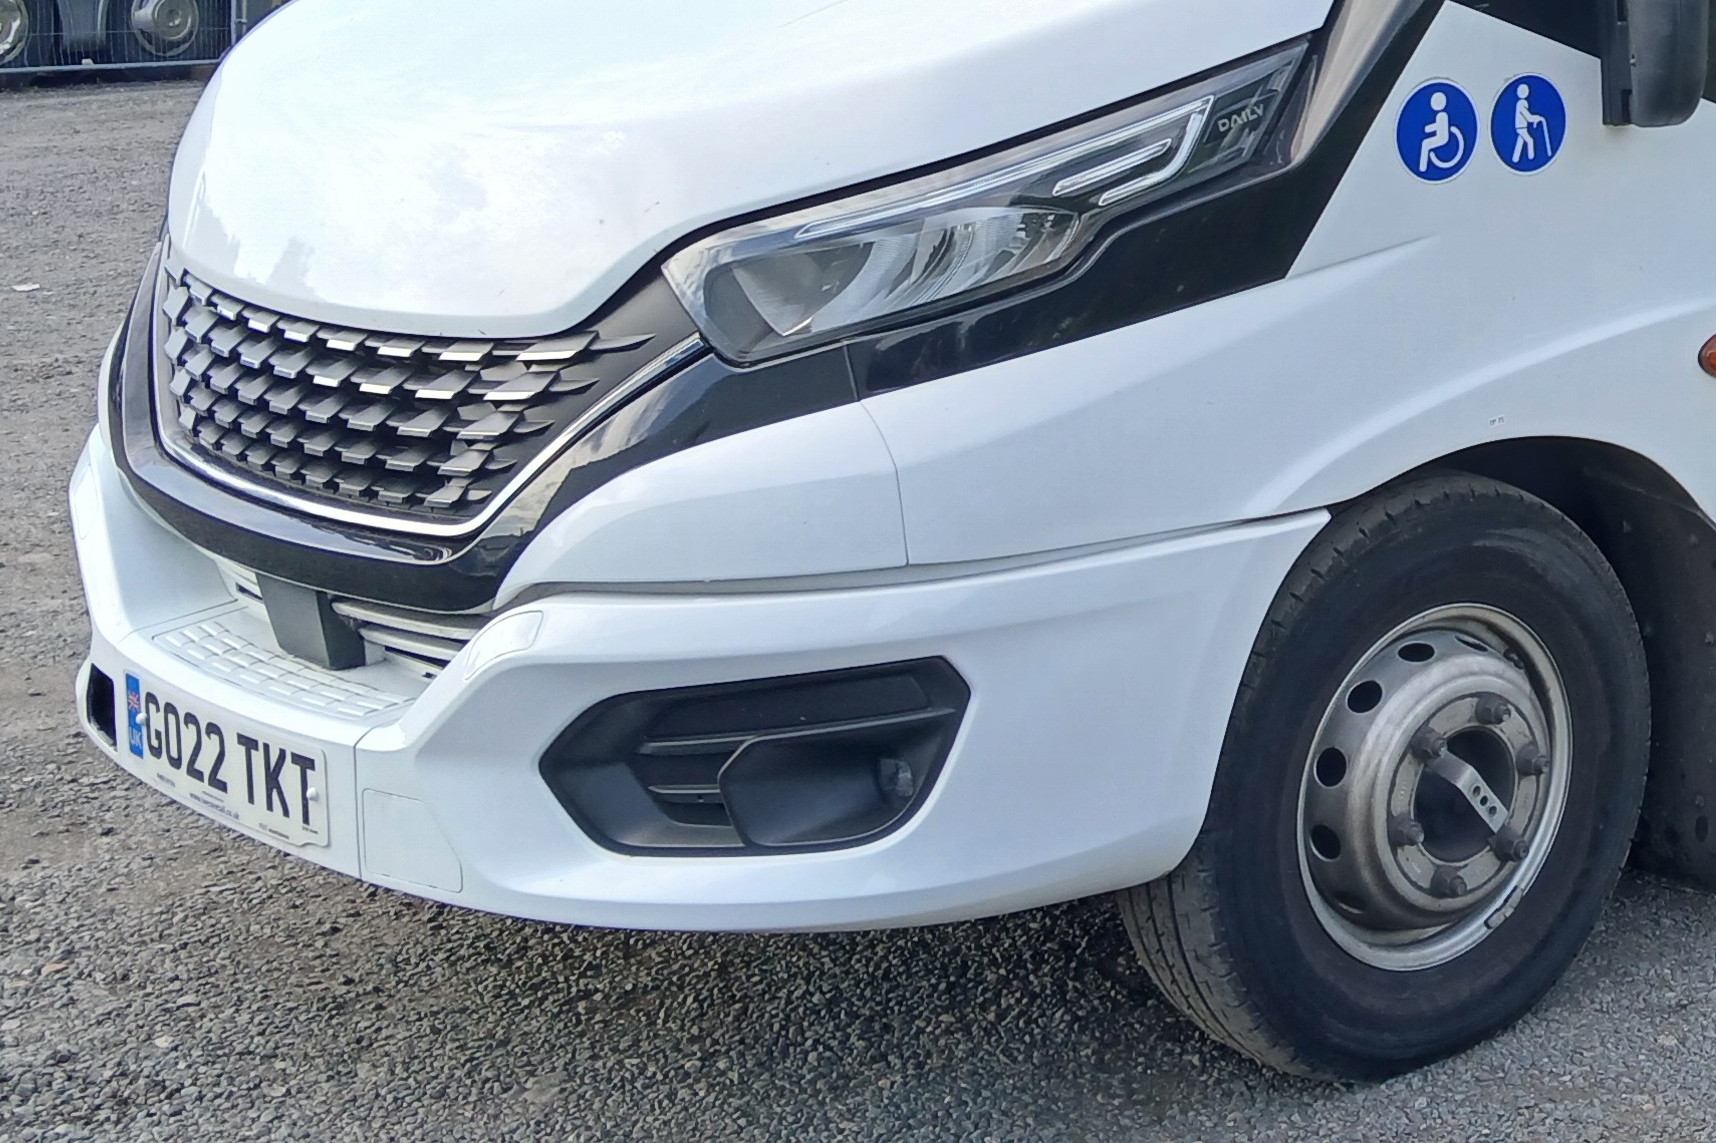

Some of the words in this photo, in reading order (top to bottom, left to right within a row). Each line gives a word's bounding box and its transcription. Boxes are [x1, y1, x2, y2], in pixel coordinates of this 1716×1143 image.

[1217, 103, 1264, 132] DAILY
[129, 725, 143, 750] UK
[145, 691, 228, 794] GO22
[236, 732, 316, 826] TKT
